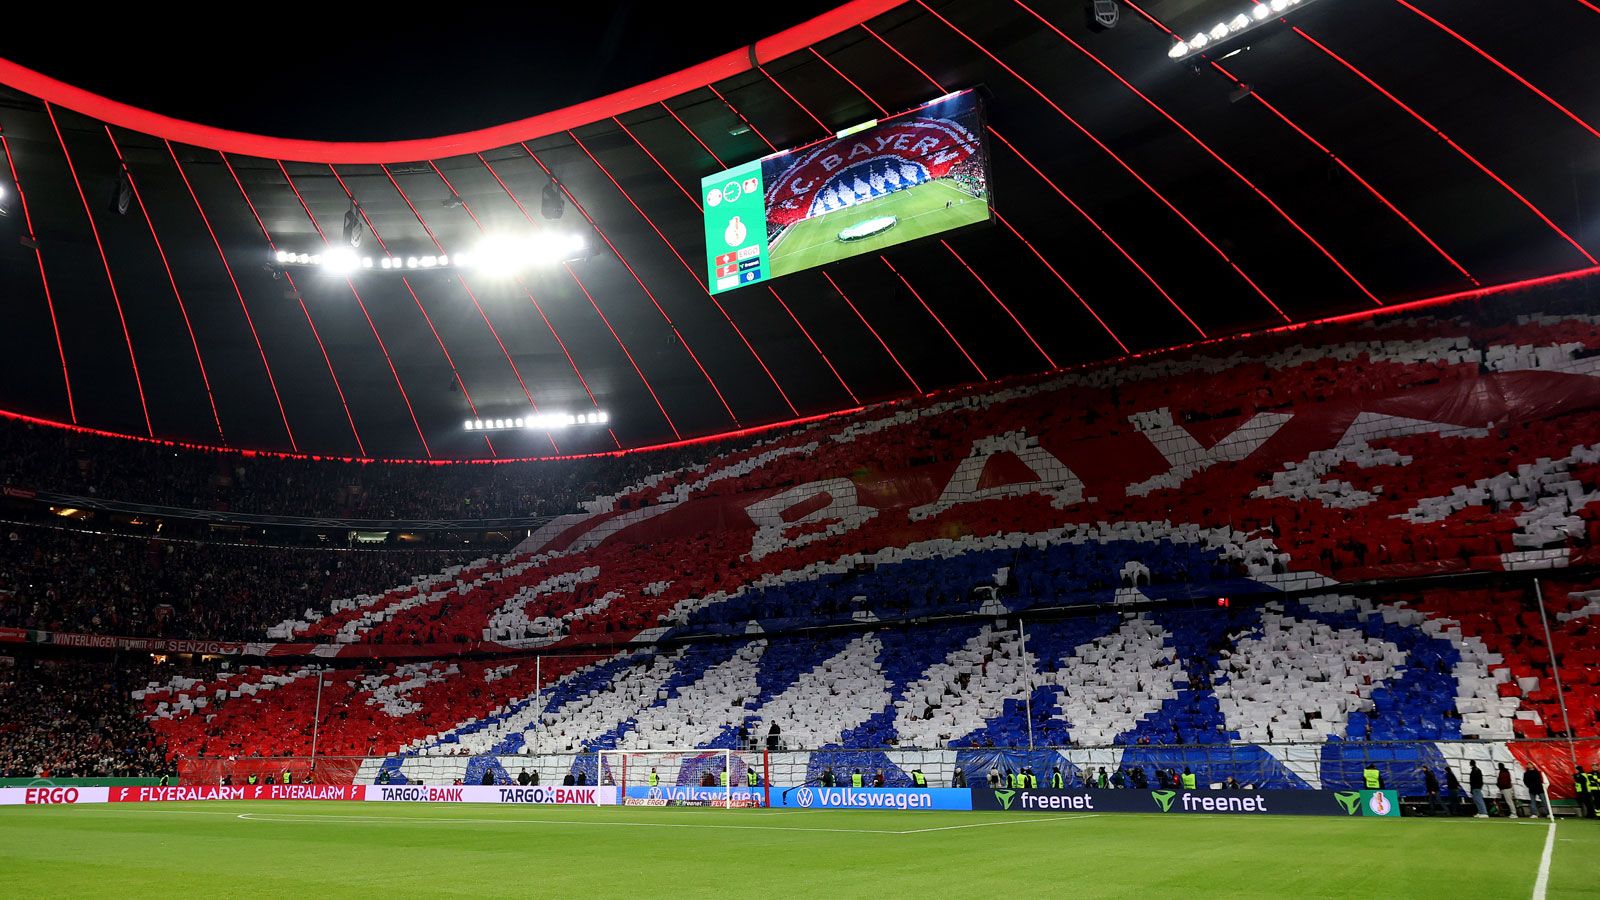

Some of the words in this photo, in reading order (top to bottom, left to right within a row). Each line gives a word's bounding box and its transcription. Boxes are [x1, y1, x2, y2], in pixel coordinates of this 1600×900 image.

[53, 633, 117, 648] WINTERLINGEN
[168, 641, 218, 653] SENZIG
[25, 787, 79, 804] ERGO
[140, 786, 245, 801] FLYERALARM
[271, 785, 344, 799] FLYERALARM
[818, 788, 932, 809] Volkswagen
[1021, 791, 1094, 809] freenet
[1182, 793, 1267, 811] freenet
